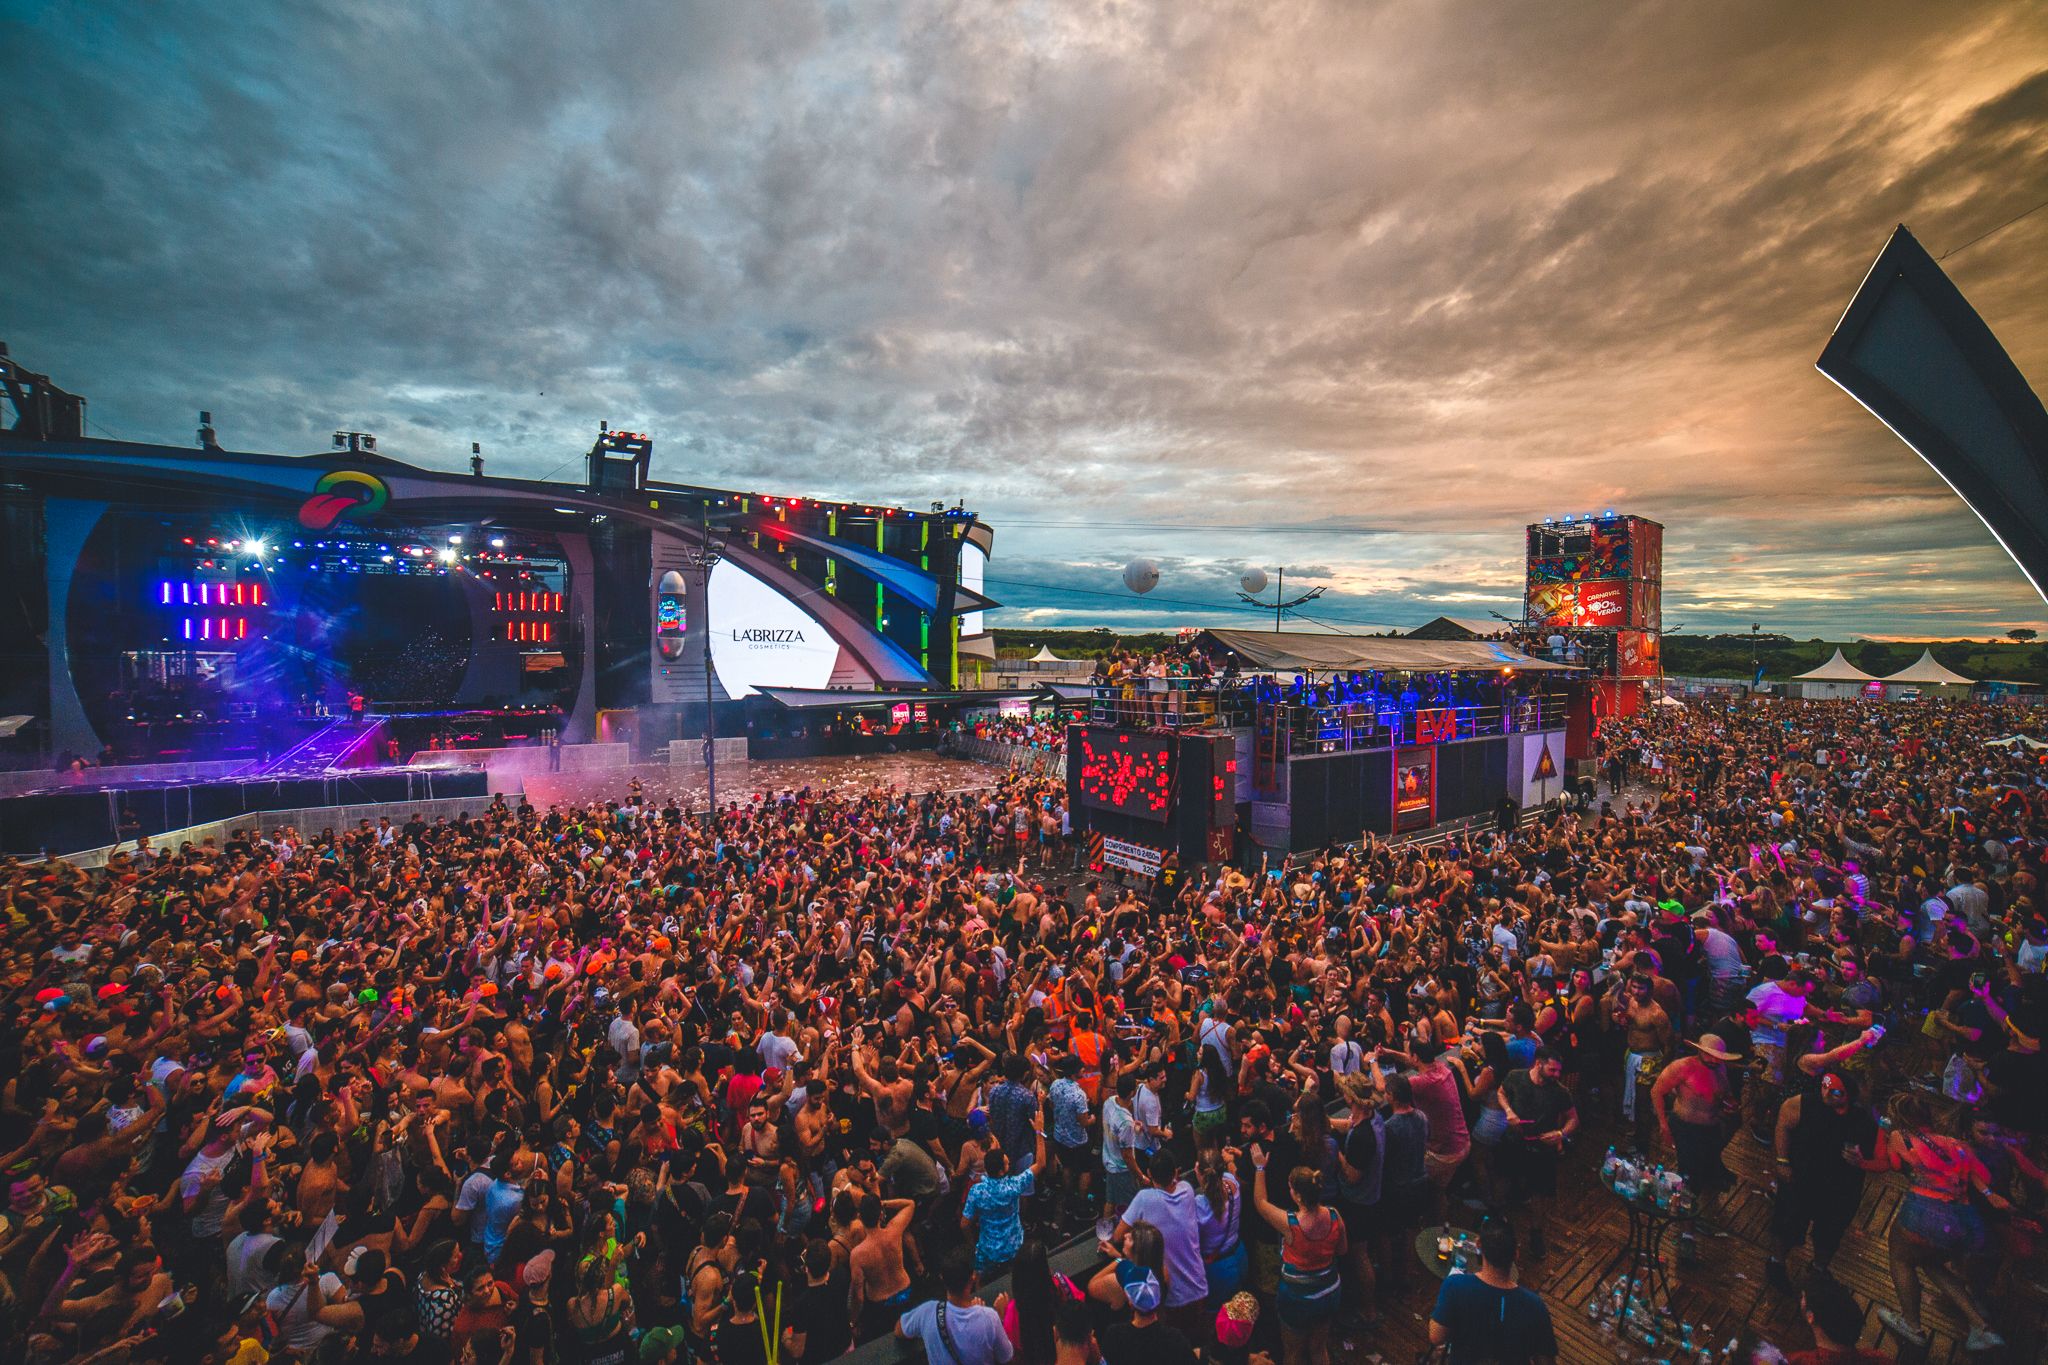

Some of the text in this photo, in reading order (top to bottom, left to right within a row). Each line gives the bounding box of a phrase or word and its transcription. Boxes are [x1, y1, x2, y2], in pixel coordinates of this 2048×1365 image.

[1587, 590, 1620, 601] CARNAVAL
[1587, 600, 1616, 612] 100%
[1416, 710, 1456, 744] EVA
[1105, 840, 1141, 856] COMPRIMENTO
[1105, 853, 1129, 868] LARGURA
